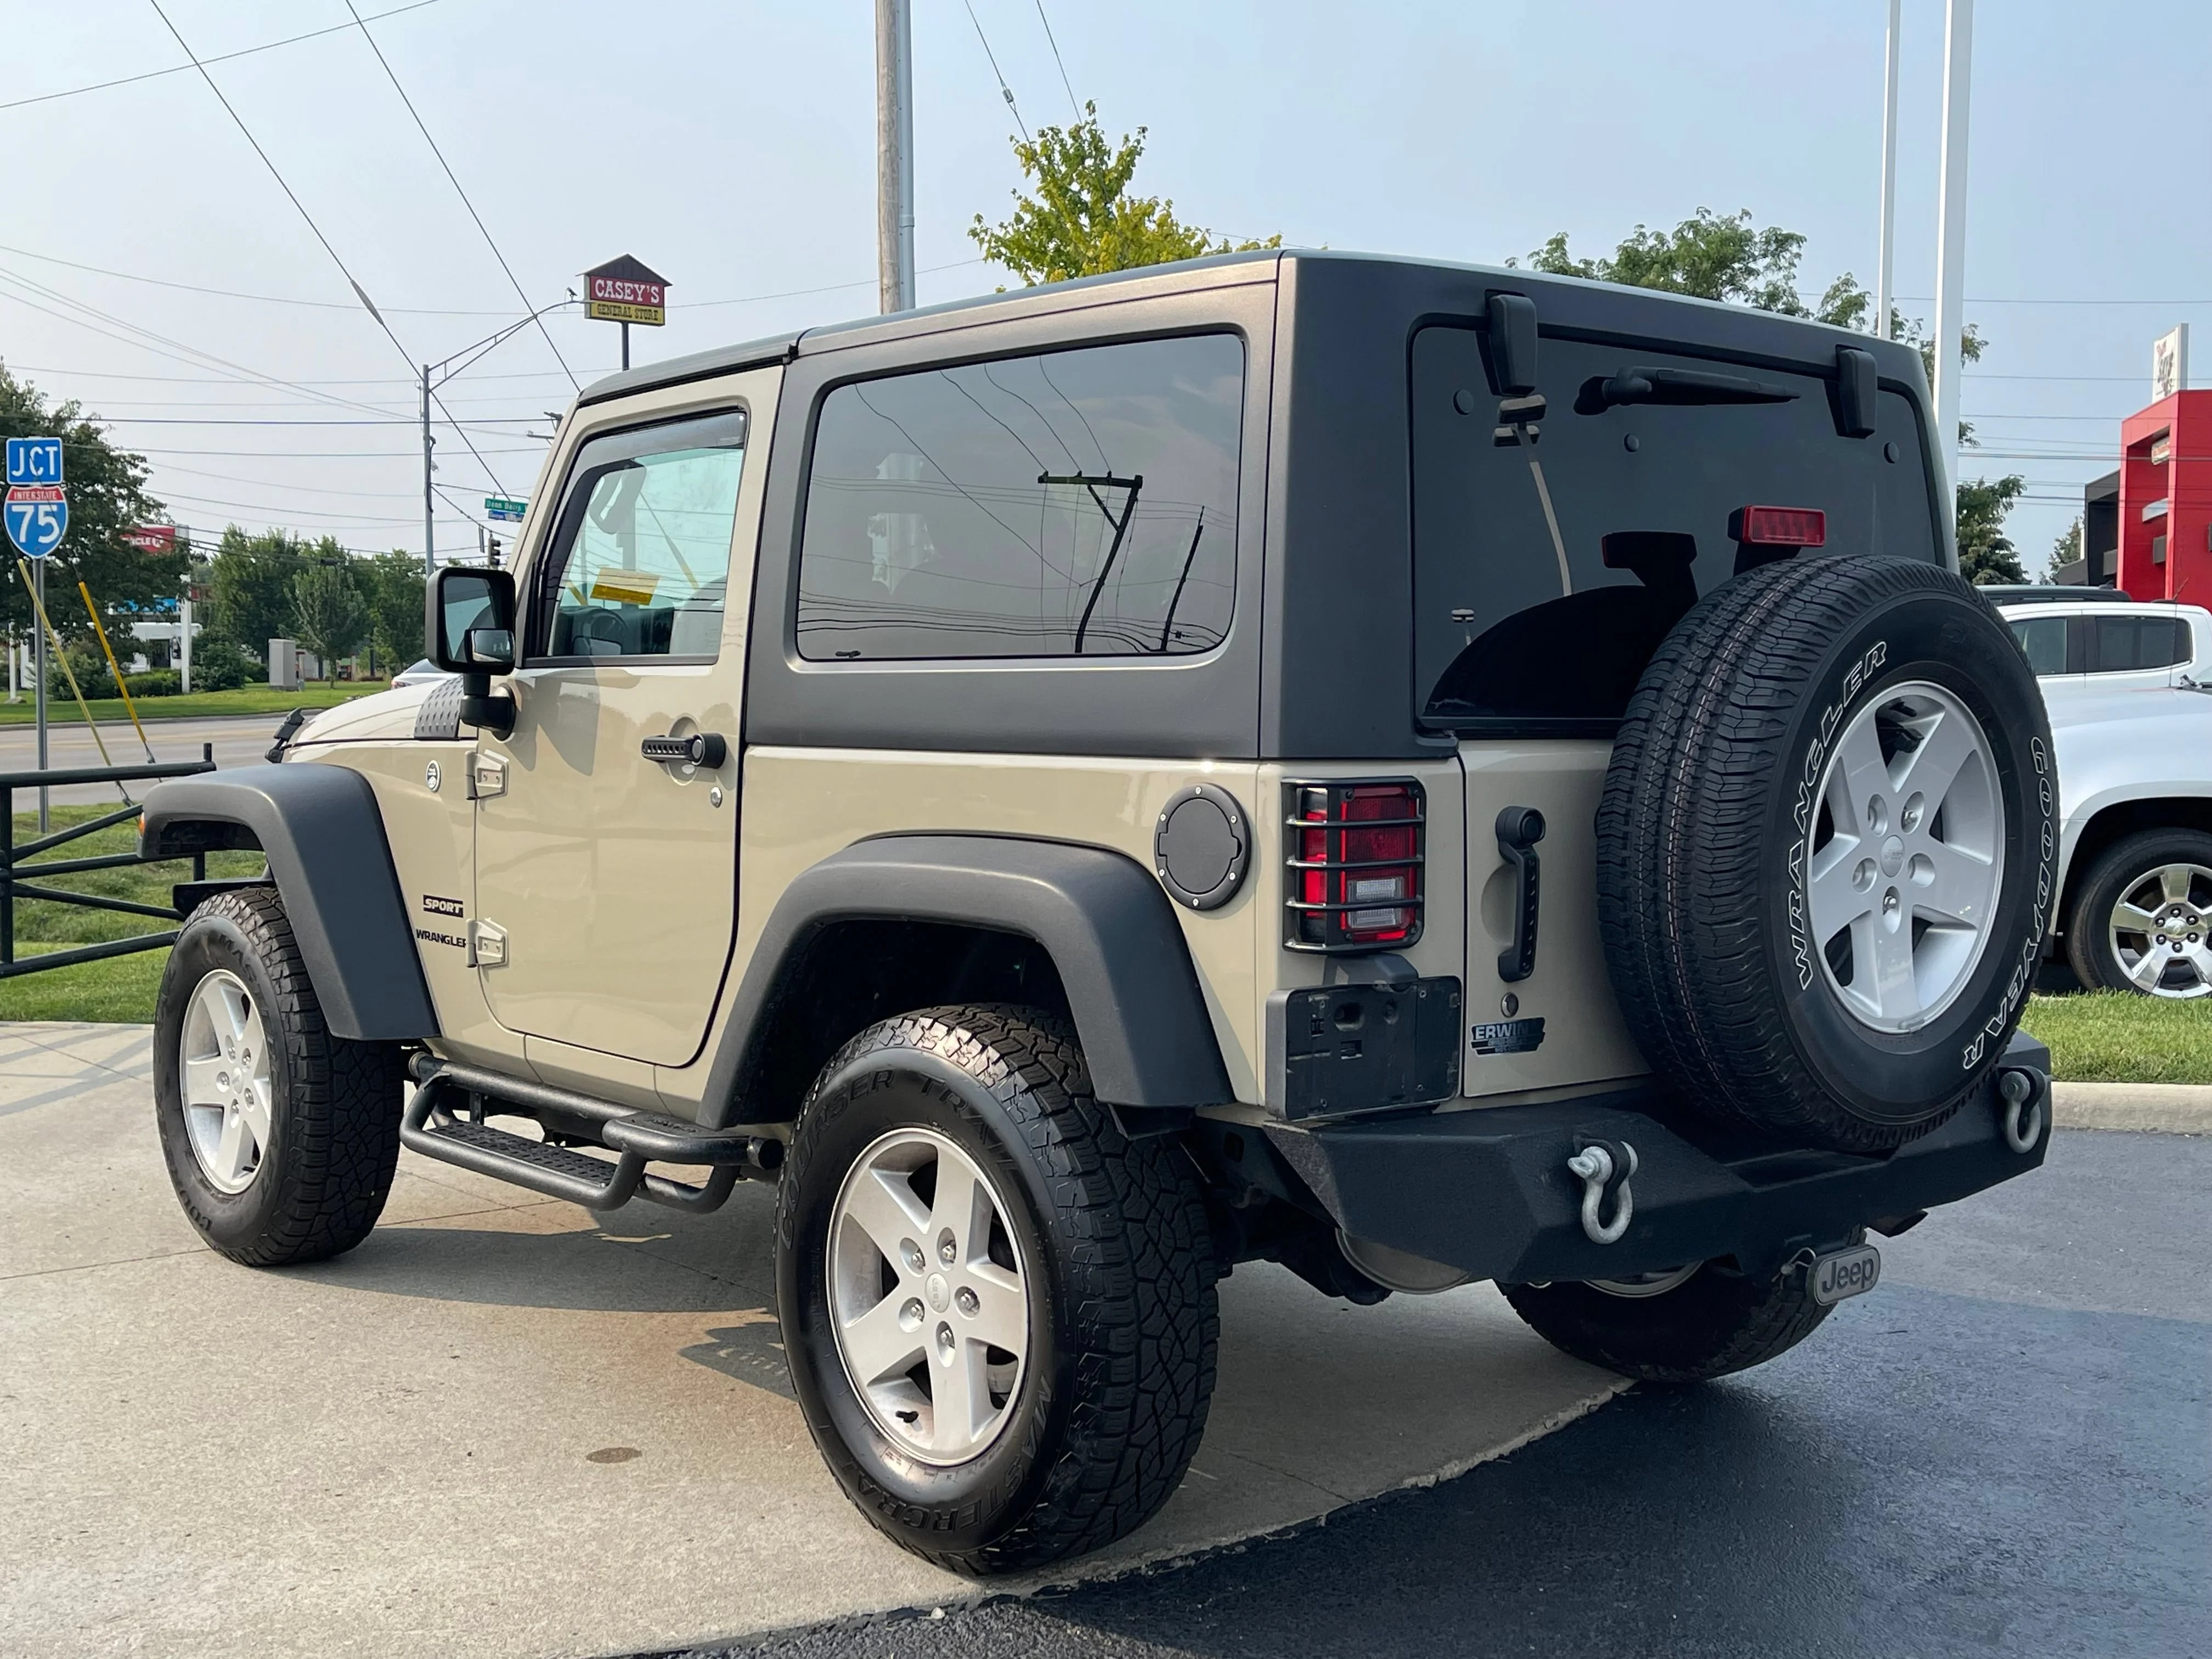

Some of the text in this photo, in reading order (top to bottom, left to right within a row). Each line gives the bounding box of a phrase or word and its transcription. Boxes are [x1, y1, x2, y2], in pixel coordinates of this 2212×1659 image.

[595, 279, 659, 303] CASEY'S
[597, 303, 658, 321] GENERAL STORE
[11, 446, 58, 477] JCT
[14, 491, 57, 500] INTERSTATE
[11, 504, 60, 544] 75
[1788, 641, 1887, 991] WRANGLER
[424, 898, 464, 914] SPORT
[1962, 736, 2053, 1071] GOODYEAR
[1475, 1022, 1530, 1040] ERWIN
[781, 1069, 895, 1250] COURSER
[1821, 1258, 1874, 1294] Jeep
